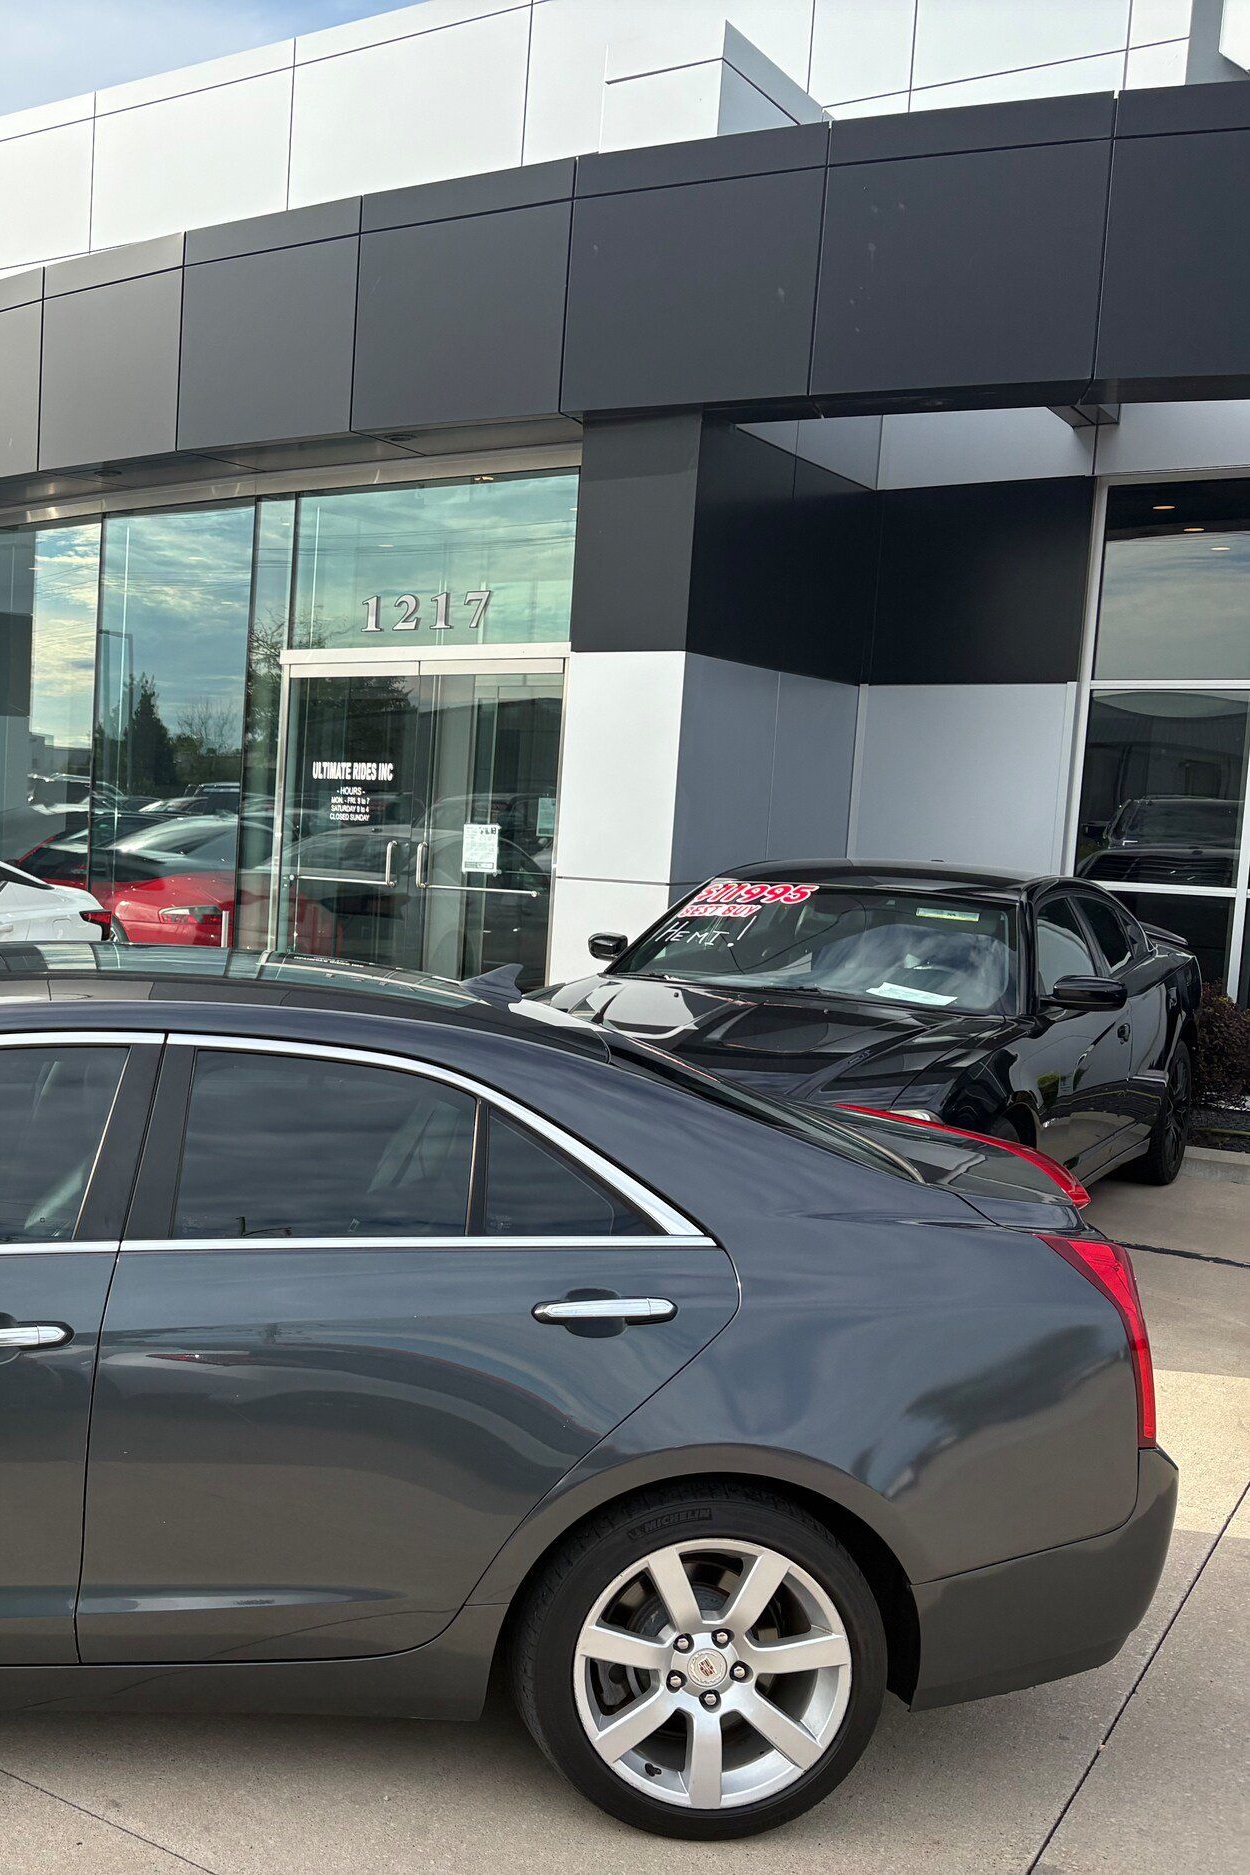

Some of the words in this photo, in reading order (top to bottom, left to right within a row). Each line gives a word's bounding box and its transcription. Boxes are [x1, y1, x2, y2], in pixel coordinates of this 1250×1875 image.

[360, 590, 492, 633] 1217
[312, 761, 352, 780] ULTIMATE
[352, 762, 377, 780] RIDES
[378, 762, 394, 781] INC
[340, 786, 362, 796] HOURS
[329, 812, 350, 821] CLOSED
[350, 813, 370, 822] SUNDAY
[330, 804, 357, 813] SATURDAY
[694, 883, 820, 905] $11995
[677, 904, 724, 918] BEST
[722, 904, 762, 918] BUY
[643, 1508, 711, 1533] MICHELIN
